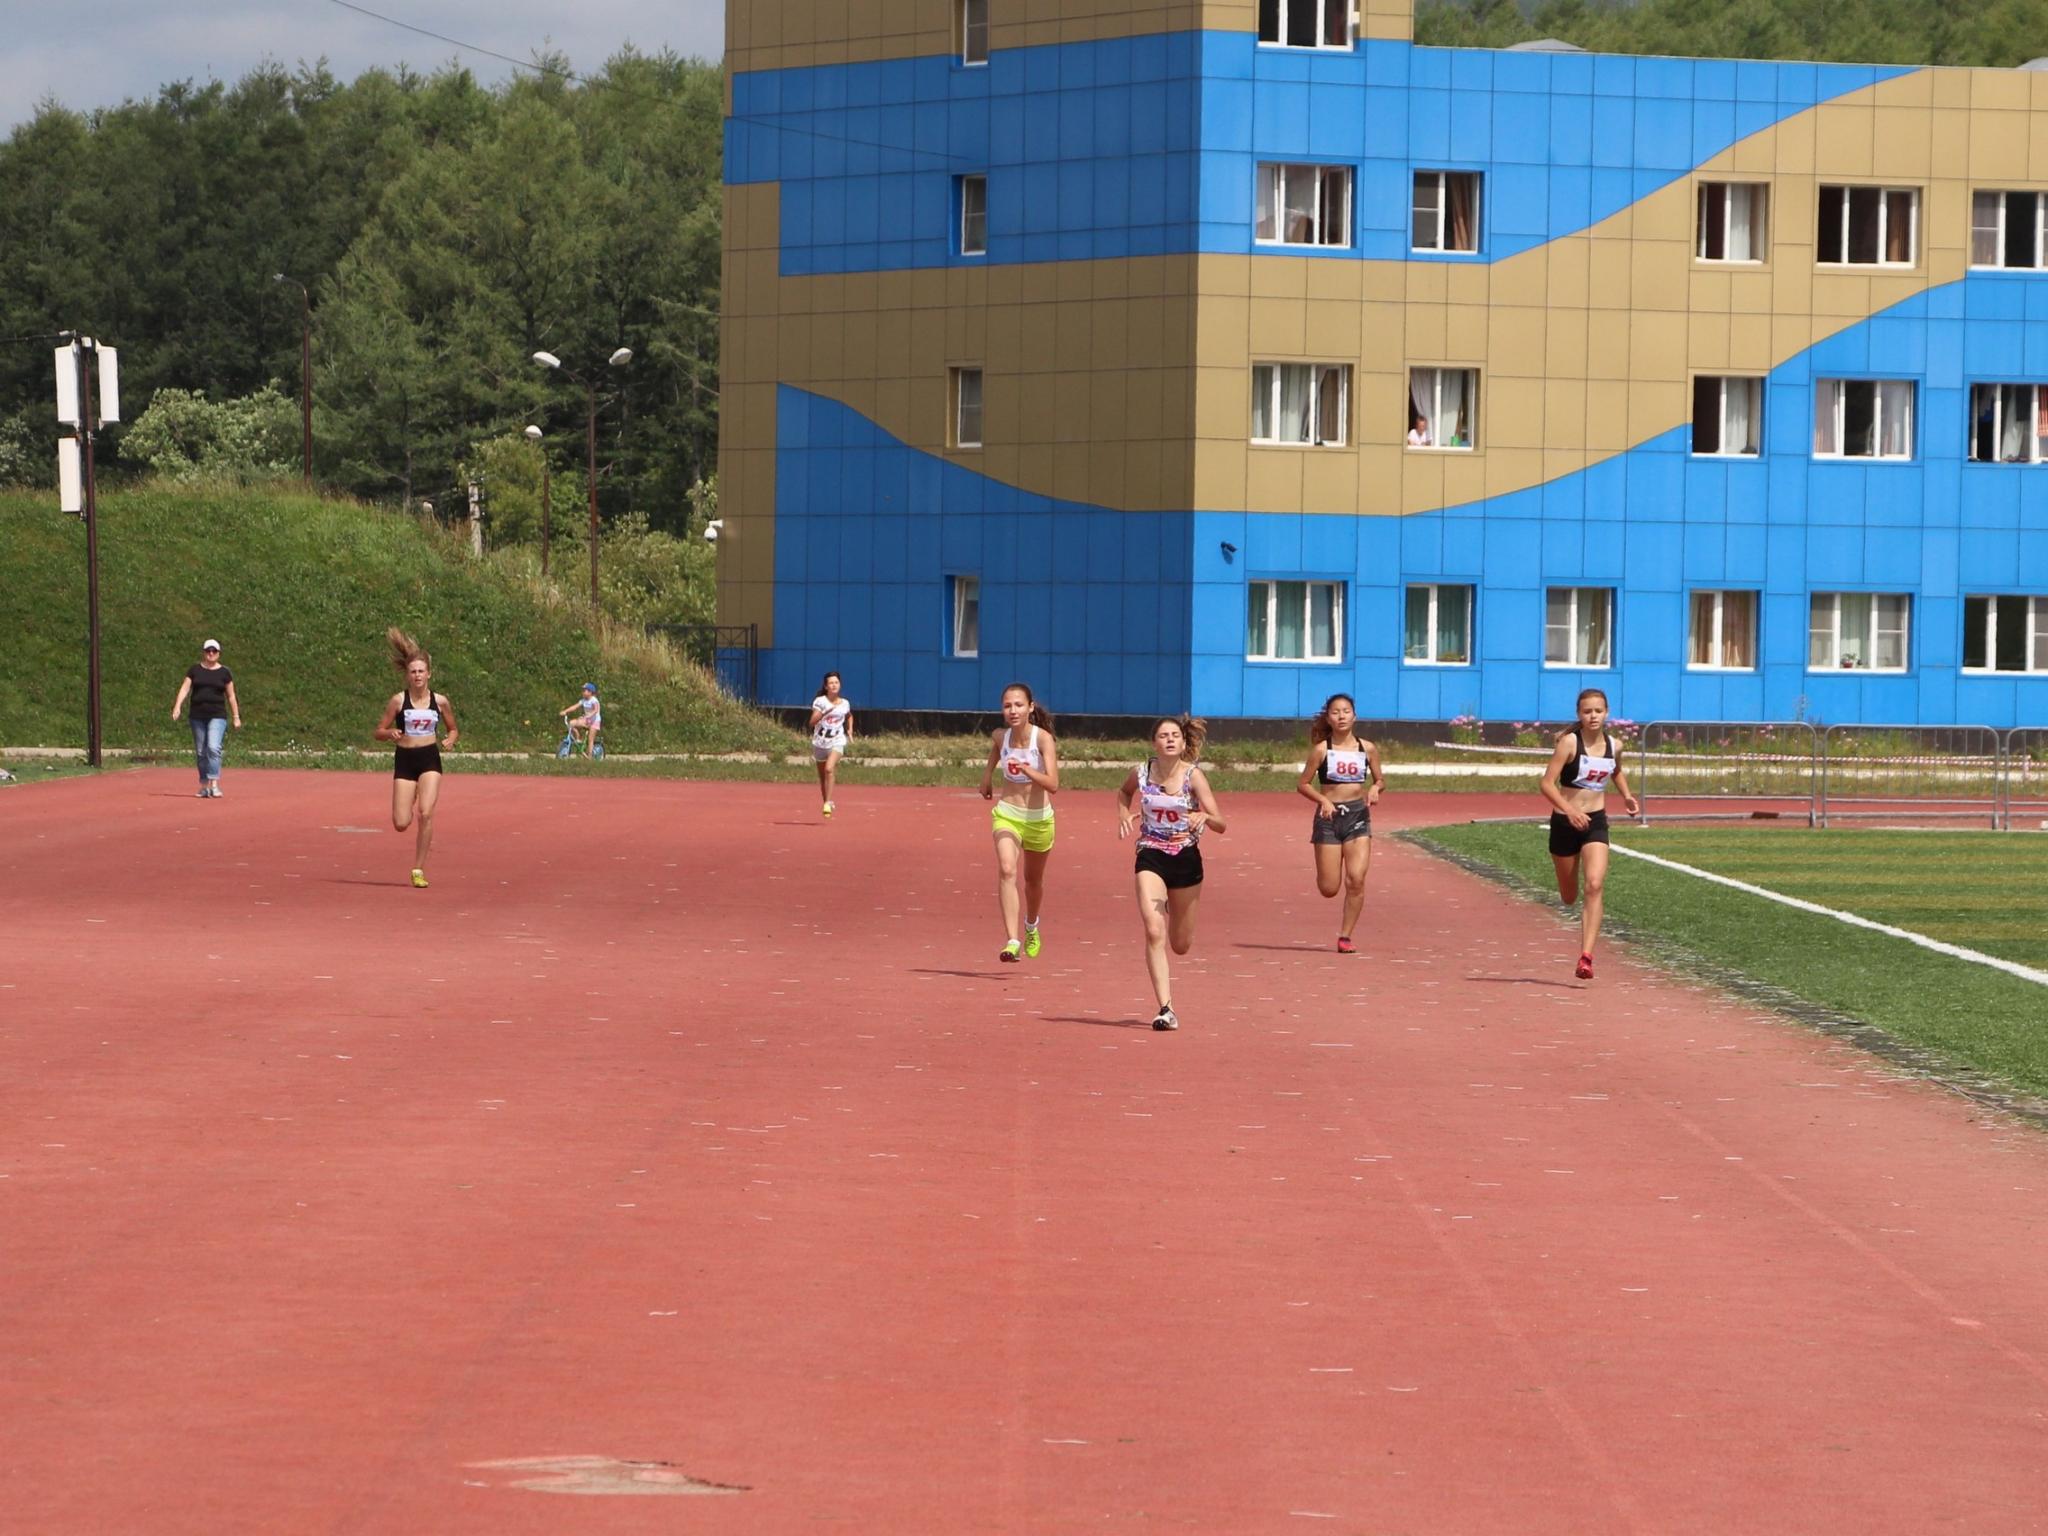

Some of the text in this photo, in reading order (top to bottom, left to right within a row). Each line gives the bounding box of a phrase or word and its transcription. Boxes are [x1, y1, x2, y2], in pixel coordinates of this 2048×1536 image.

[411, 719, 432, 730] 77
[1336, 761, 1358, 775] 86
[1151, 808, 1180, 823] 70
